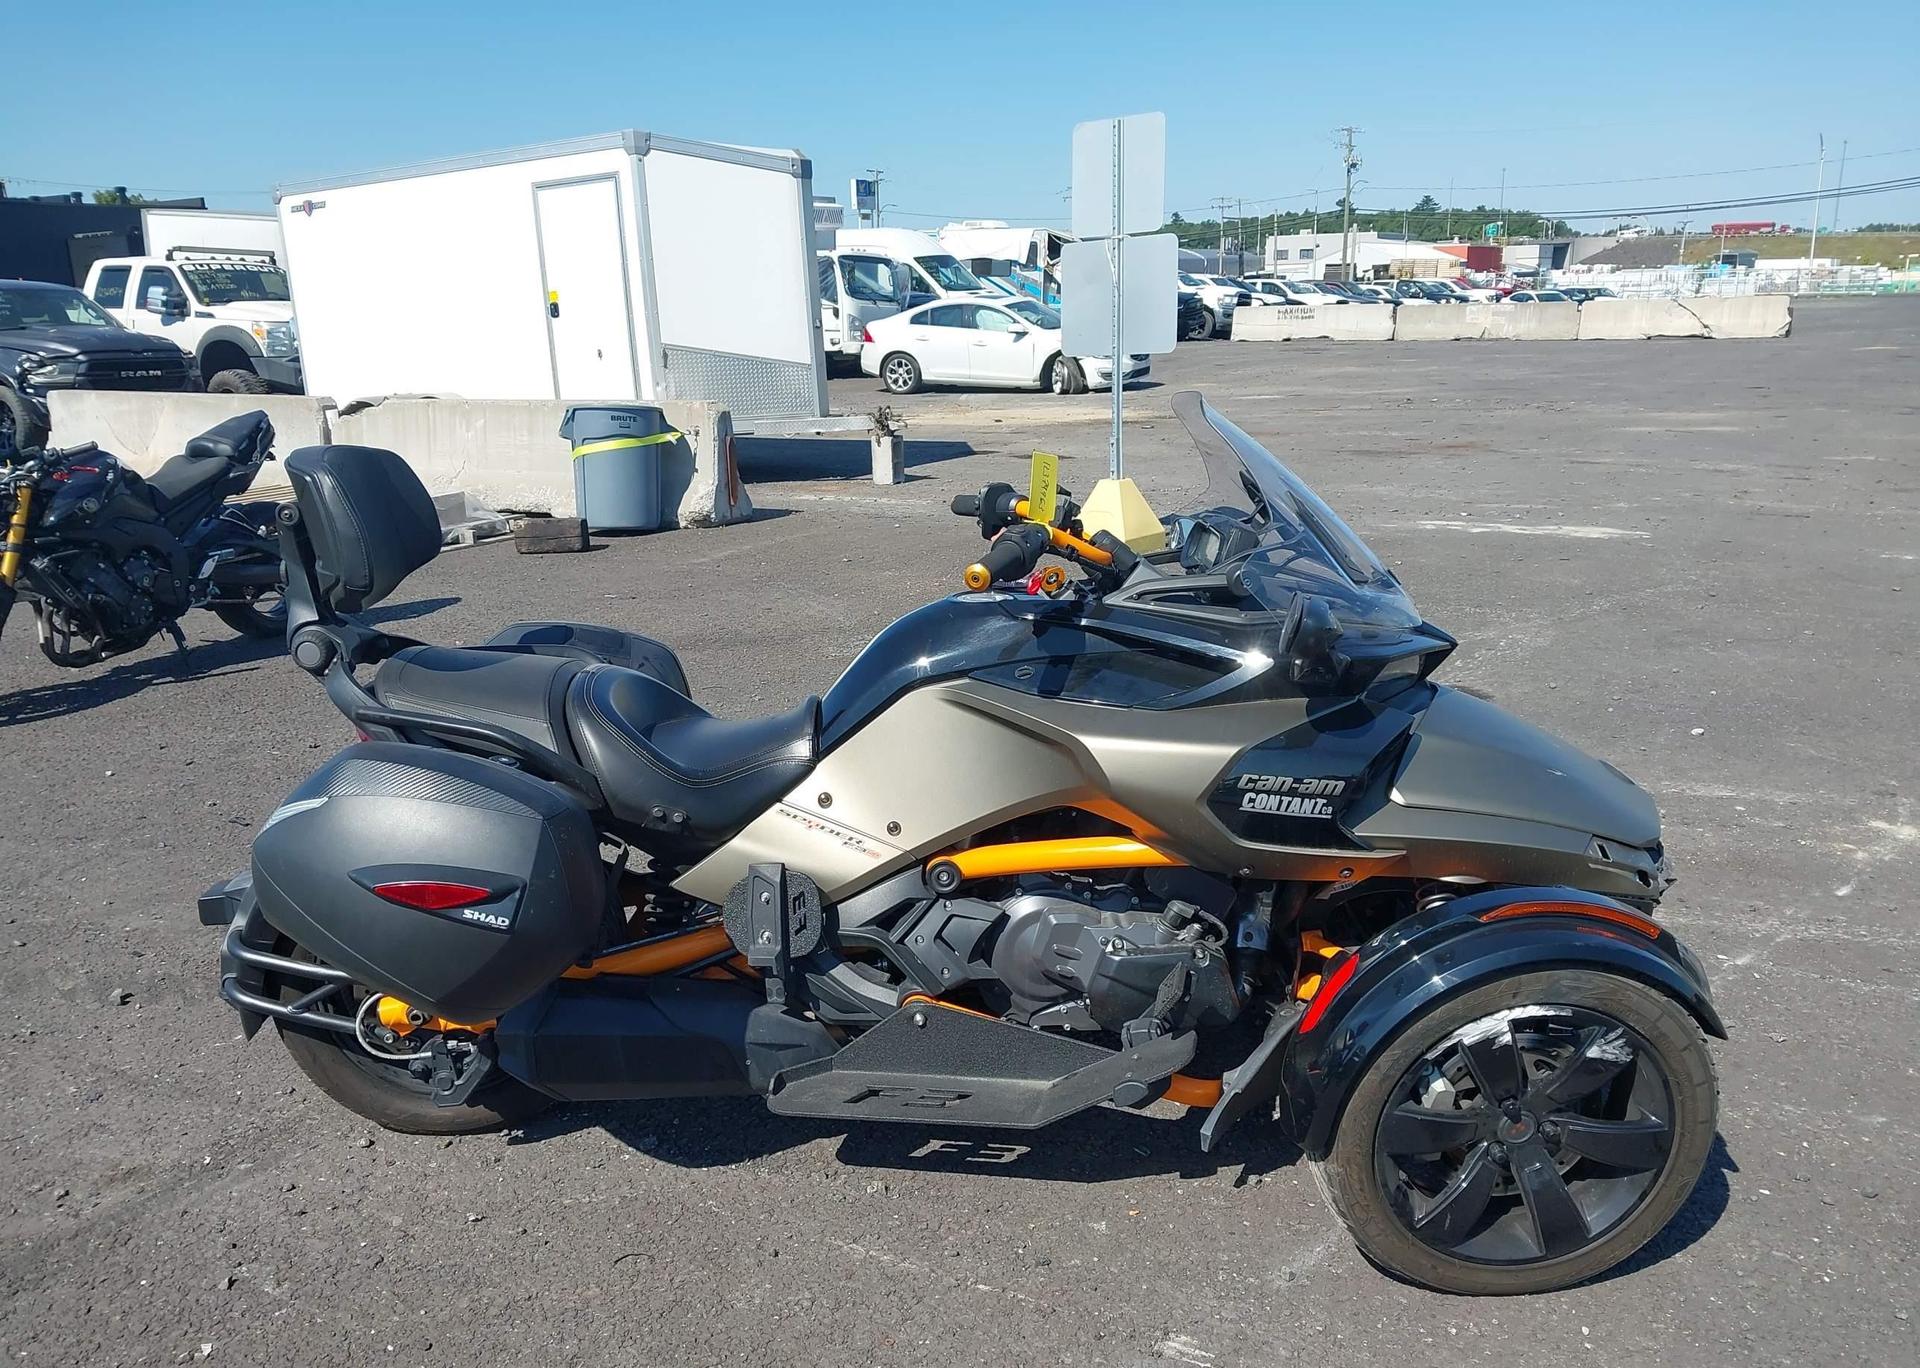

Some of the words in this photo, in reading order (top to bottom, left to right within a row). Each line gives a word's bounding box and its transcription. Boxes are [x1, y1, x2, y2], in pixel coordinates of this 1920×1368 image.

[610, 415, 638, 423] BRUTE
[462, 909, 511, 926] SHAD
[792, 890, 808, 937] F3
[842, 1085, 974, 1109] F3
[908, 1138, 1032, 1164] F3
